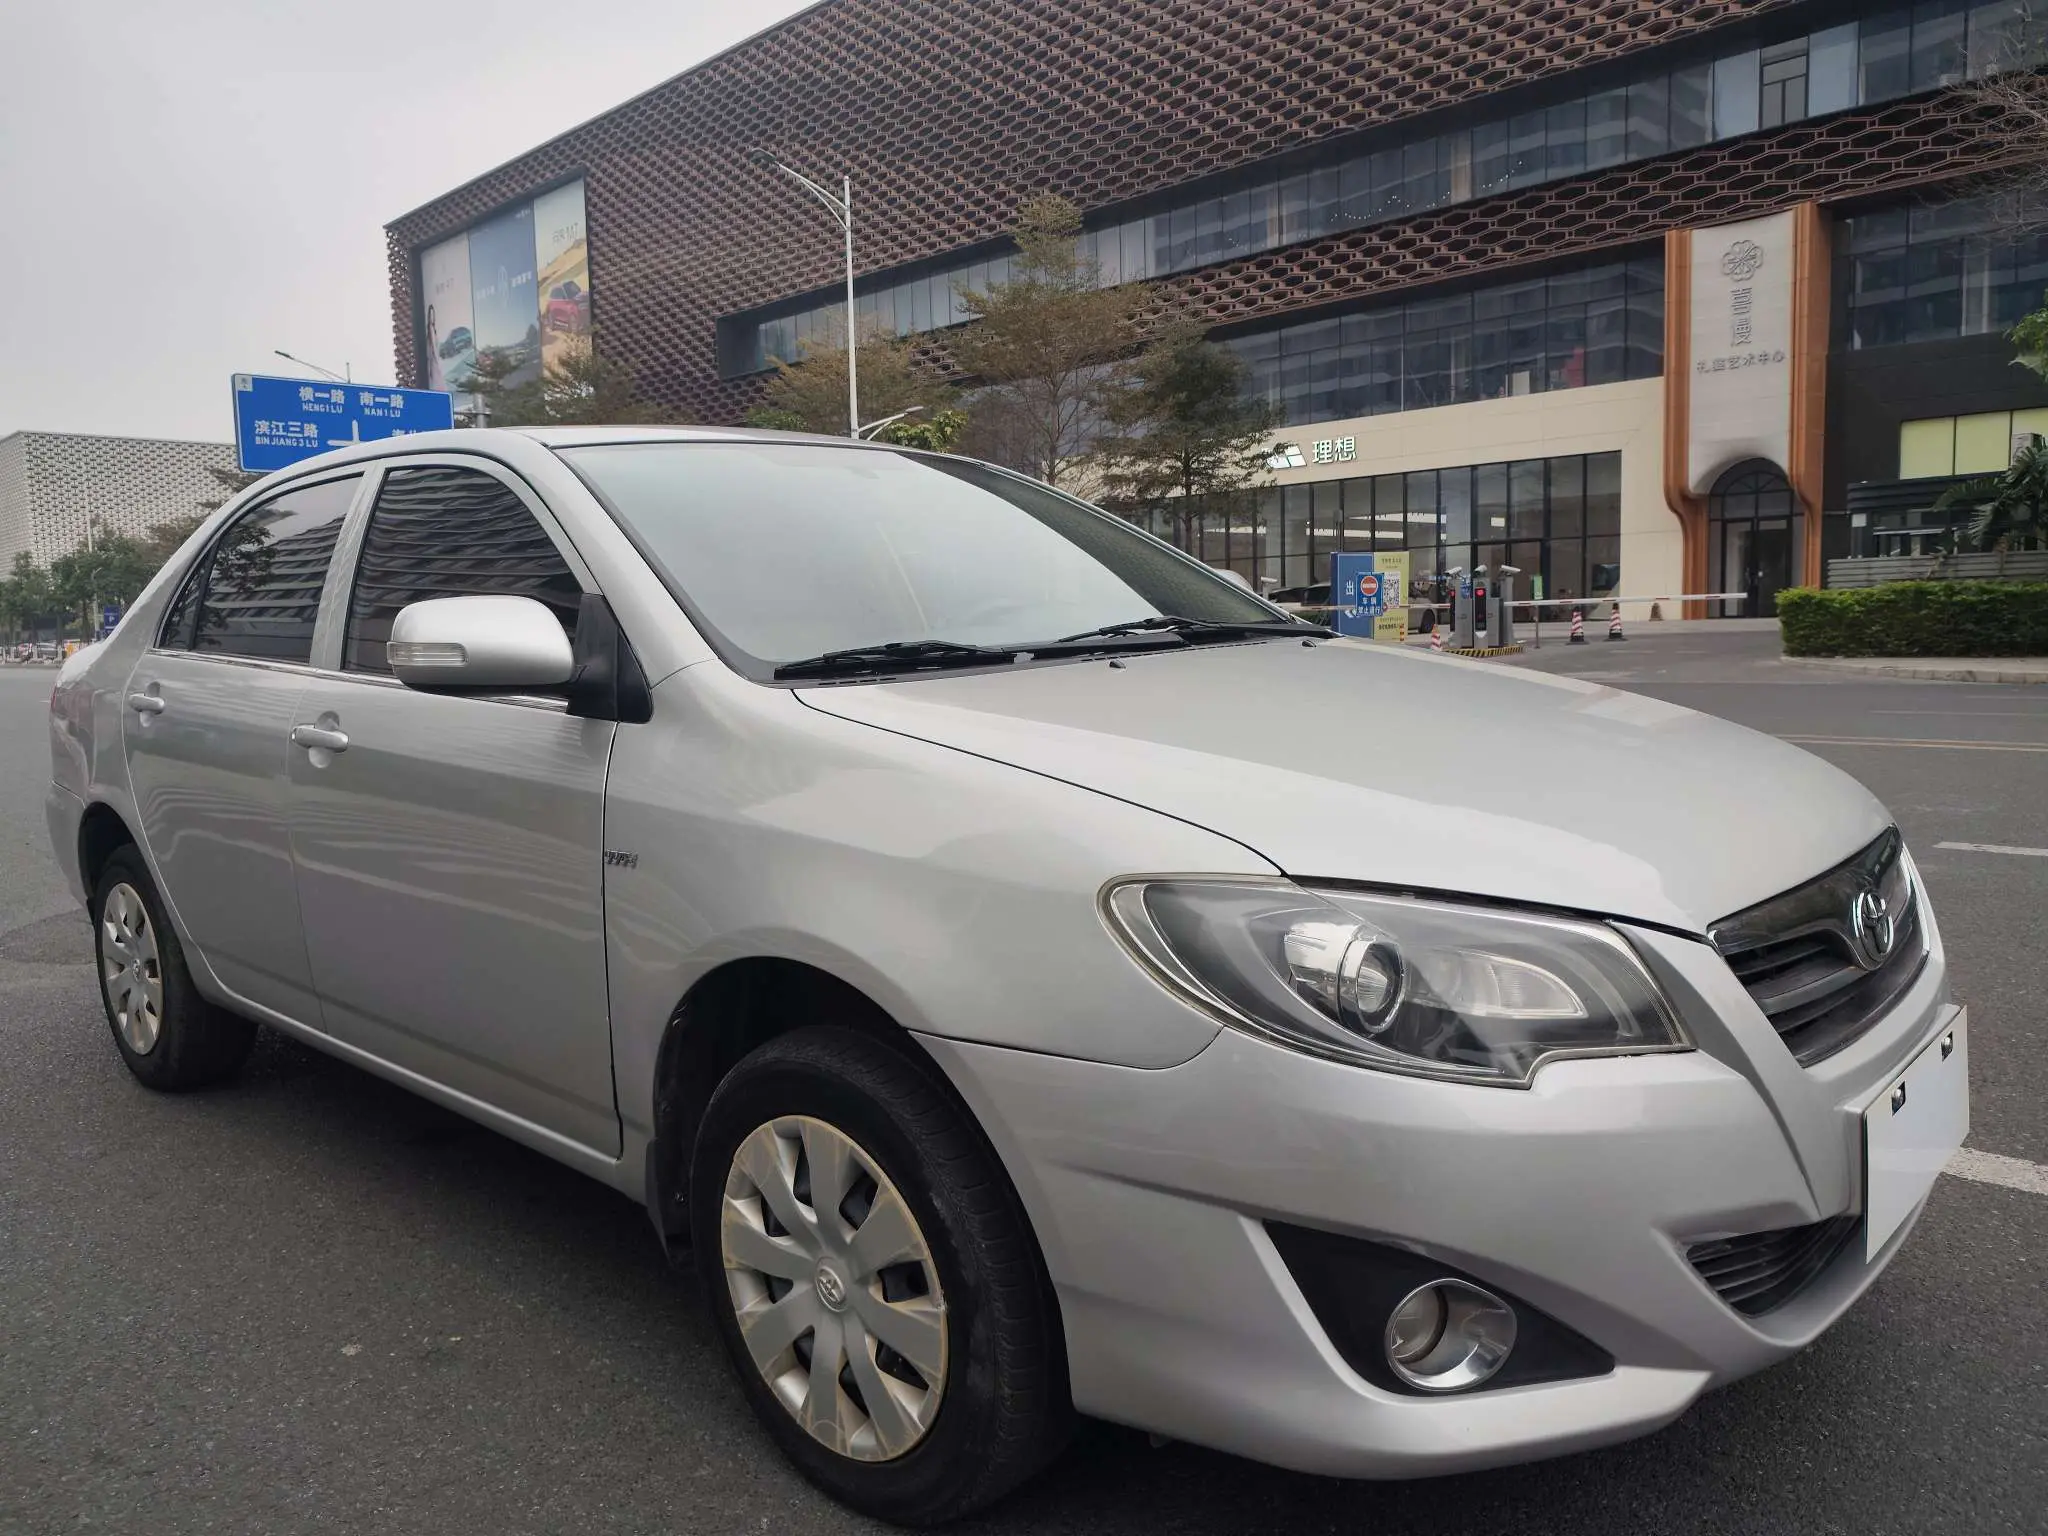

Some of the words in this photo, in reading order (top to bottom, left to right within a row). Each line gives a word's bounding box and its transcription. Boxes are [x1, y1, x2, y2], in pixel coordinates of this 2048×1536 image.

[299, 386, 345, 405] 横一路
[359, 392, 404, 409] 南一路
[390, 408, 401, 418] LU
[254, 420, 318, 438] 滨江三路
[306, 439, 318, 448] LU
[1312, 436, 1357, 464] 理想
